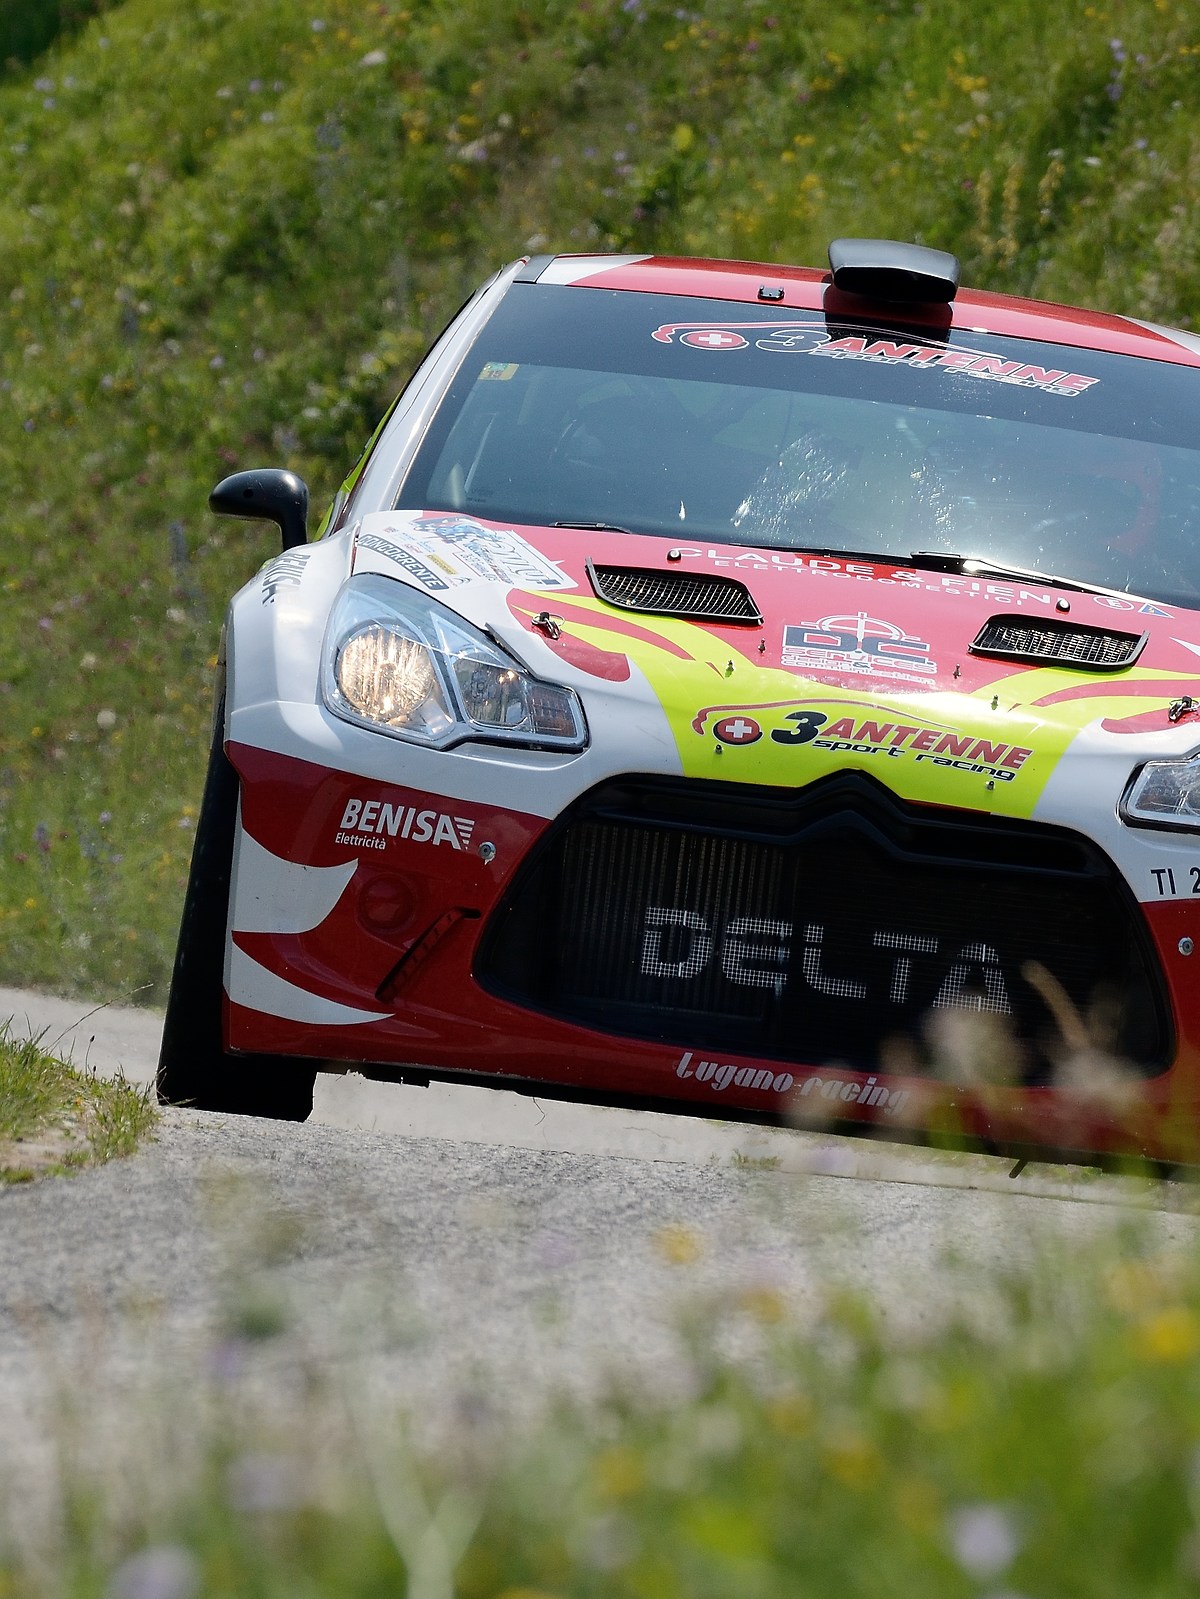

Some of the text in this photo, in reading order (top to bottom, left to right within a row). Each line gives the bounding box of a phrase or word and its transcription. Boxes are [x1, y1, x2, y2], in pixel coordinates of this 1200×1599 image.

[360, 534, 443, 588] CONCORRENTE
[667, 547, 875, 576] CLAUDE
[714, 560, 1022, 606] ELETTRODOMESTICI
[812, 739, 1017, 783] sport racing
[335, 832, 386, 850] Elettricità
[340, 798, 461, 851] BENISA
[1150, 868, 1177, 896] TI
[641, 907, 1013, 1016] DELTA
[675, 1052, 794, 1093] Lugano
